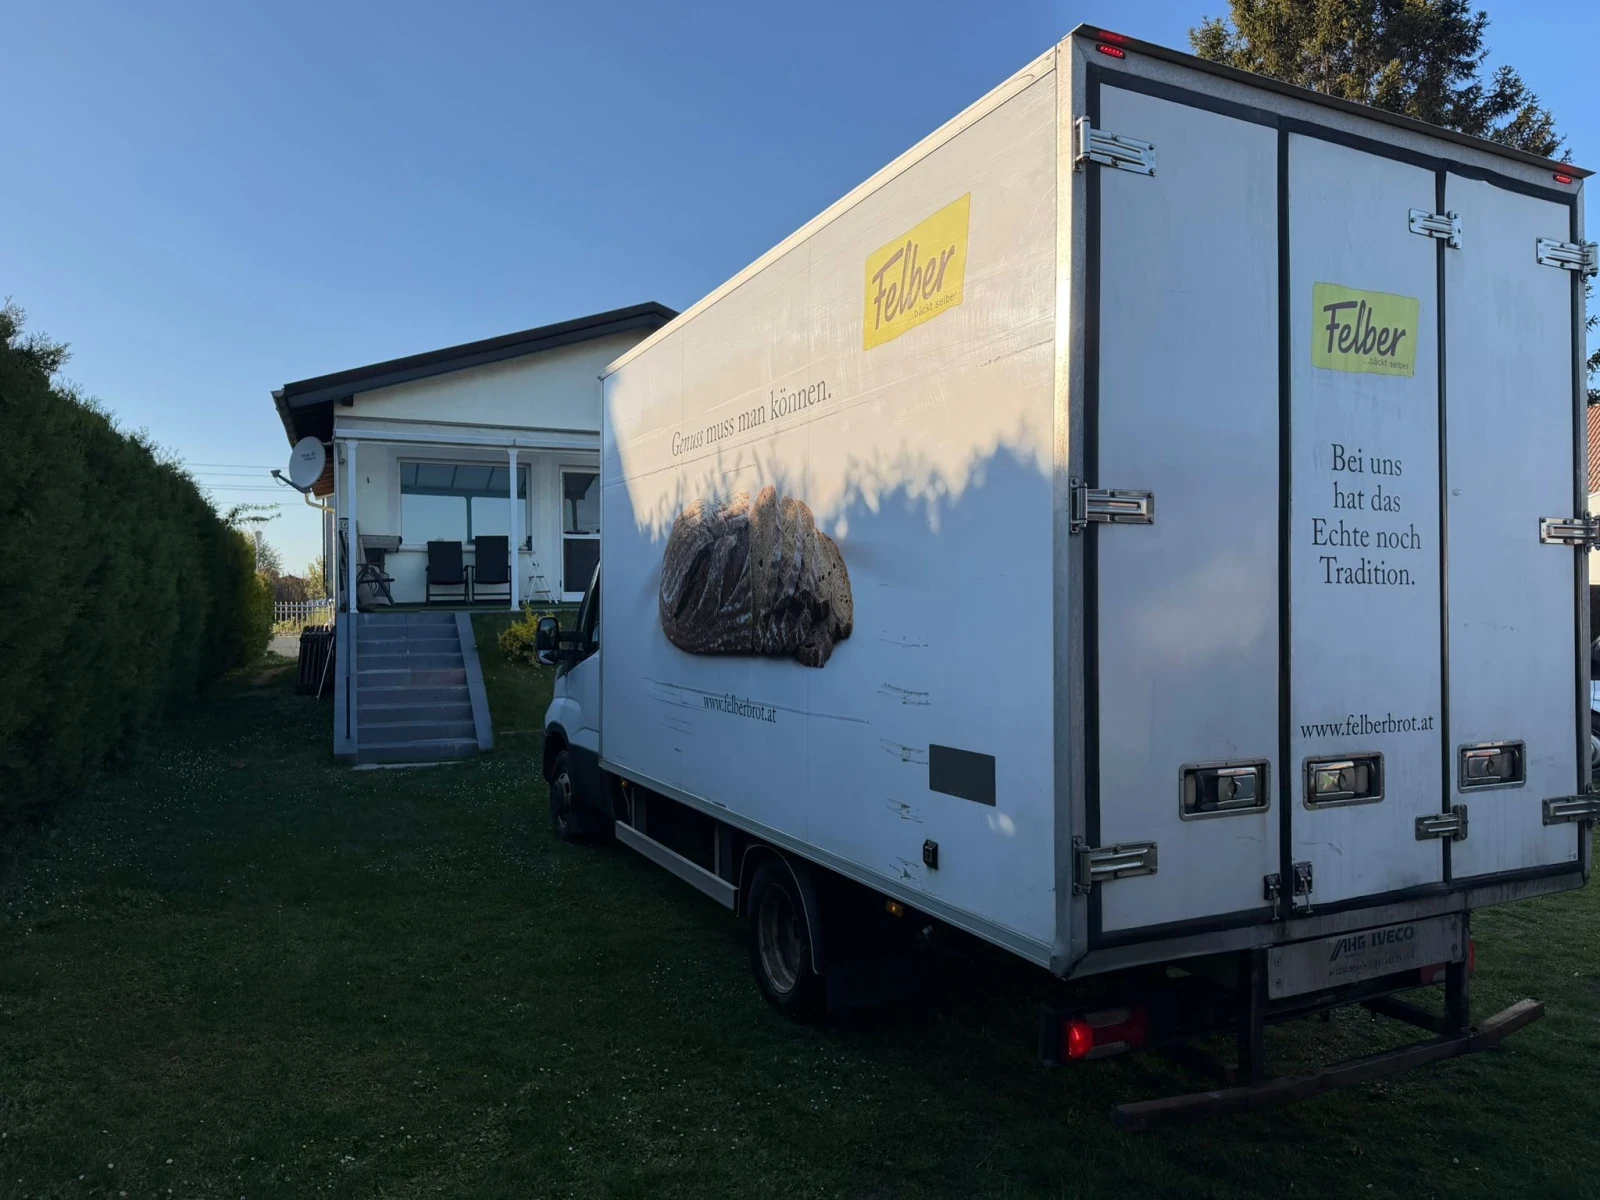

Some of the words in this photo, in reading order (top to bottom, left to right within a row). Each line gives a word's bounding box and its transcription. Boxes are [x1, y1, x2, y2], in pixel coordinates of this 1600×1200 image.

[872, 239, 955, 331] Felber
[1323, 299, 1406, 356] Felber
[1389, 360, 1409, 369] selber
[671, 428, 704, 457] Genuss
[706, 419, 734, 446] muss
[738, 407, 766, 434] man
[770, 379, 832, 420] können.
[1330, 443, 1364, 474] Bei
[1370, 457, 1403, 476] uns
[1333, 481, 1365, 511] hat
[1370, 484, 1401, 512] das
[1311, 517, 1370, 547] Echte
[1376, 523, 1421, 550] noch
[1318, 555, 1416, 585] Tradition.
[704, 694, 776, 723] www.felberbrot.at
[1300, 712, 1434, 738] www.felberbrot.at
[1372, 926, 1414, 947] IVECO
